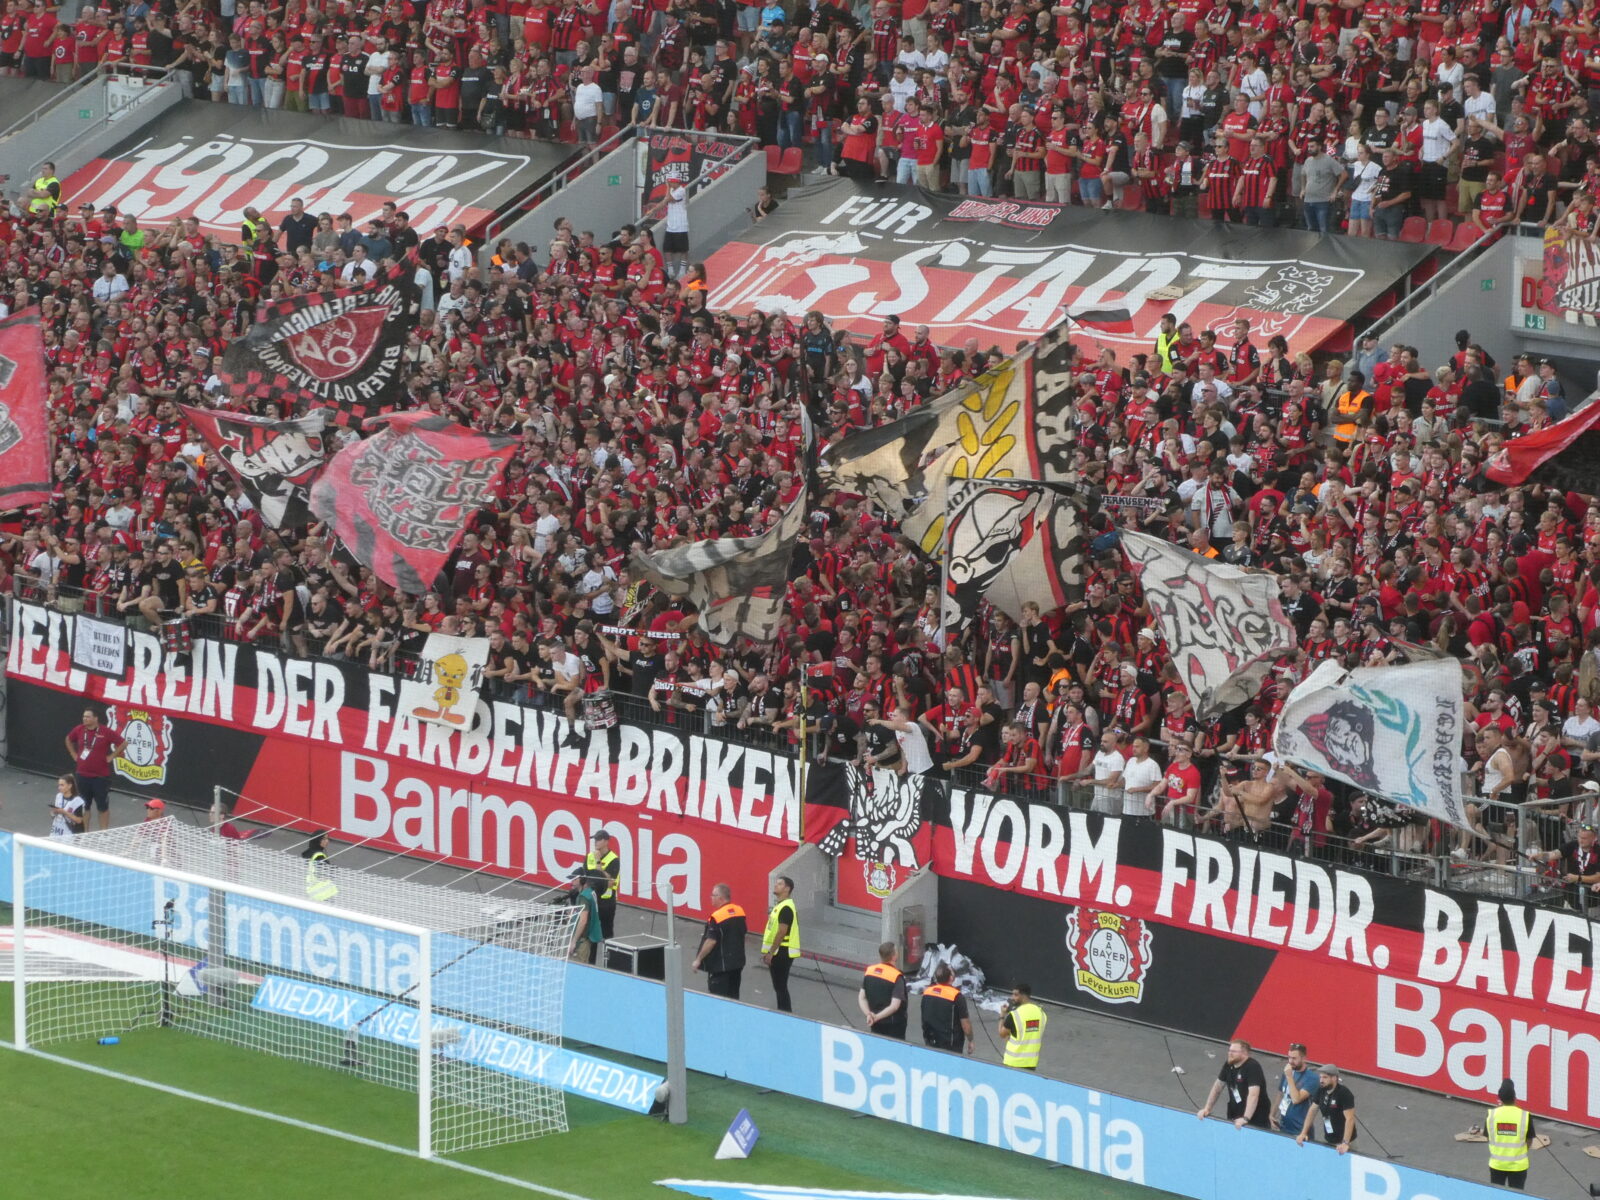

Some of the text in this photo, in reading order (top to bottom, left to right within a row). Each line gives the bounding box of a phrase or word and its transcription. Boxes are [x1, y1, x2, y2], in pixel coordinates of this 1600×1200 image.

[820, 194, 933, 235] FÜR
[849, 240, 1271, 338] STADT
[252, 650, 347, 744] DER
[340, 750, 702, 911] Barmenia
[949, 788, 1132, 907] VORM.
[1154, 828, 1390, 968] FRIEDR.
[1099, 915, 1119, 927] 1904
[1092, 948, 1126, 963] BAYER
[1105, 932, 1113, 979] BAYER
[1081, 973, 1135, 996] Leverkusen
[561, 1058, 657, 1108] NIEDAX
[821, 1023, 1146, 1186] Barmenia
